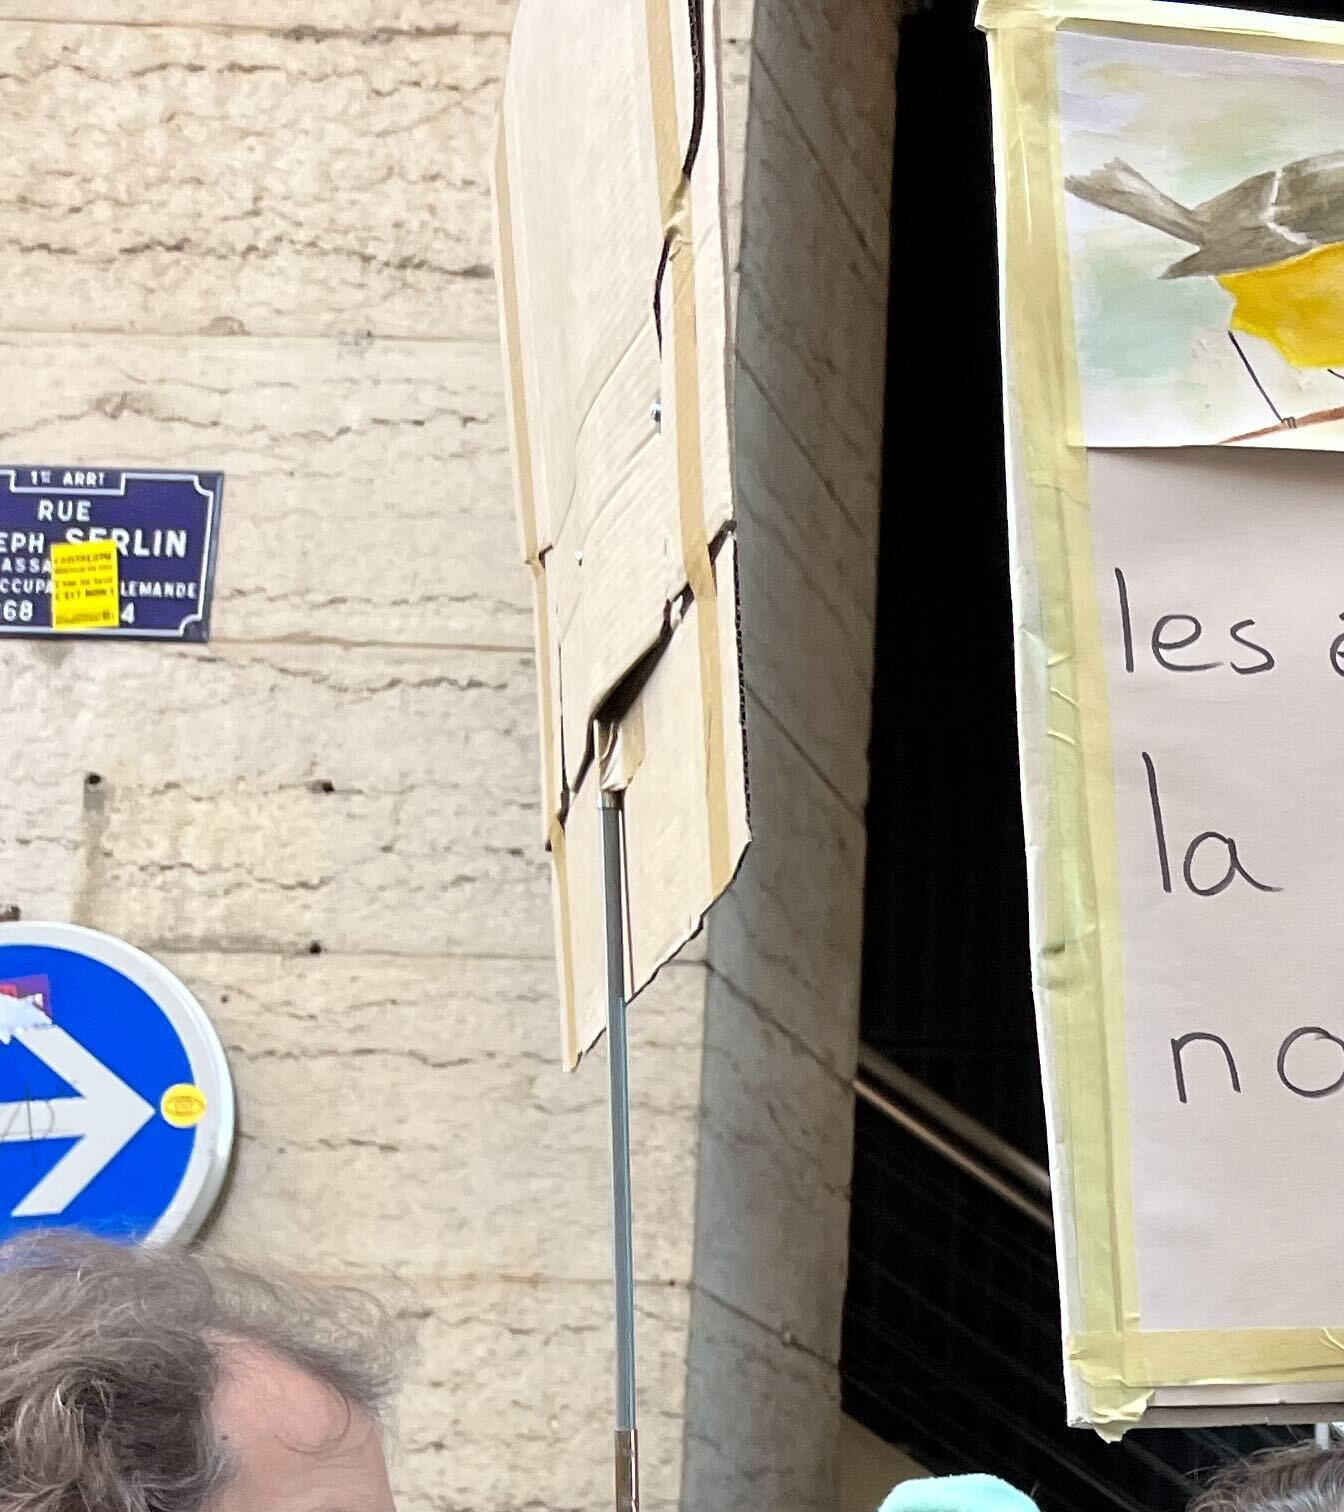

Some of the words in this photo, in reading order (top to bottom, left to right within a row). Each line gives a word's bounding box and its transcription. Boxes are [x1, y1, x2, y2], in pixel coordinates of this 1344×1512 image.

[37, 499, 92, 522] RUE
[1, 557, 52, 574] ASSA
[0, 577, 52, 594] CCUPA
[120, 580, 198, 600] LEMANDE
[1112, 565, 1277, 678] les
[1140, 750, 1285, 899] la
